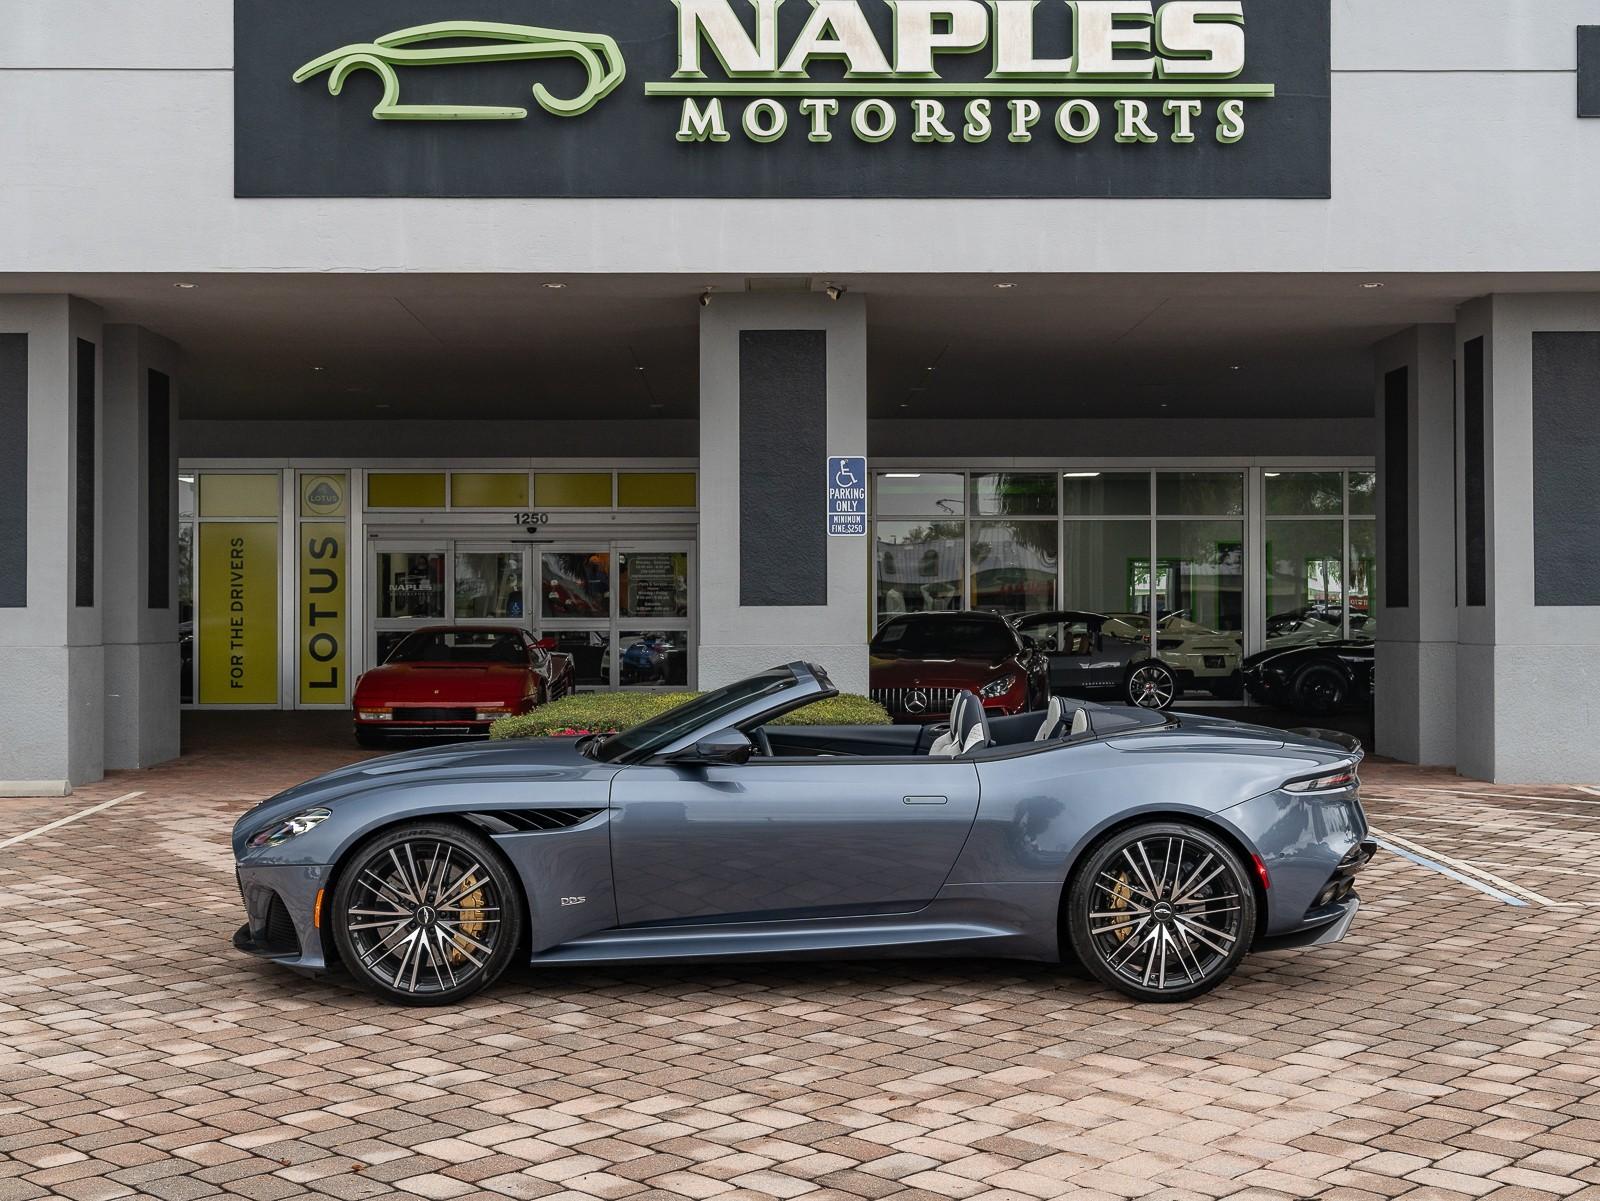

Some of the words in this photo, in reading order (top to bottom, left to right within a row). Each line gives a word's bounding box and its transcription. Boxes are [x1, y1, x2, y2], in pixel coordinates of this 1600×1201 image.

[671, 0, 1245, 79] NAPLES
[675, 98, 1245, 143] MOTORSPORTS
[829, 488, 864, 500] PARKING
[836, 500, 858, 512] ONLY
[514, 512, 548, 524] 1250
[831, 524, 846, 533] FINE
[847, 524, 863, 533] $250
[833, 515, 861, 523] MINIMUM
[230, 537, 244, 611] DRIVERS
[308, 536, 338, 688] LOTUS
[230, 617, 244, 649] THE
[230, 655, 244, 689] FOR
